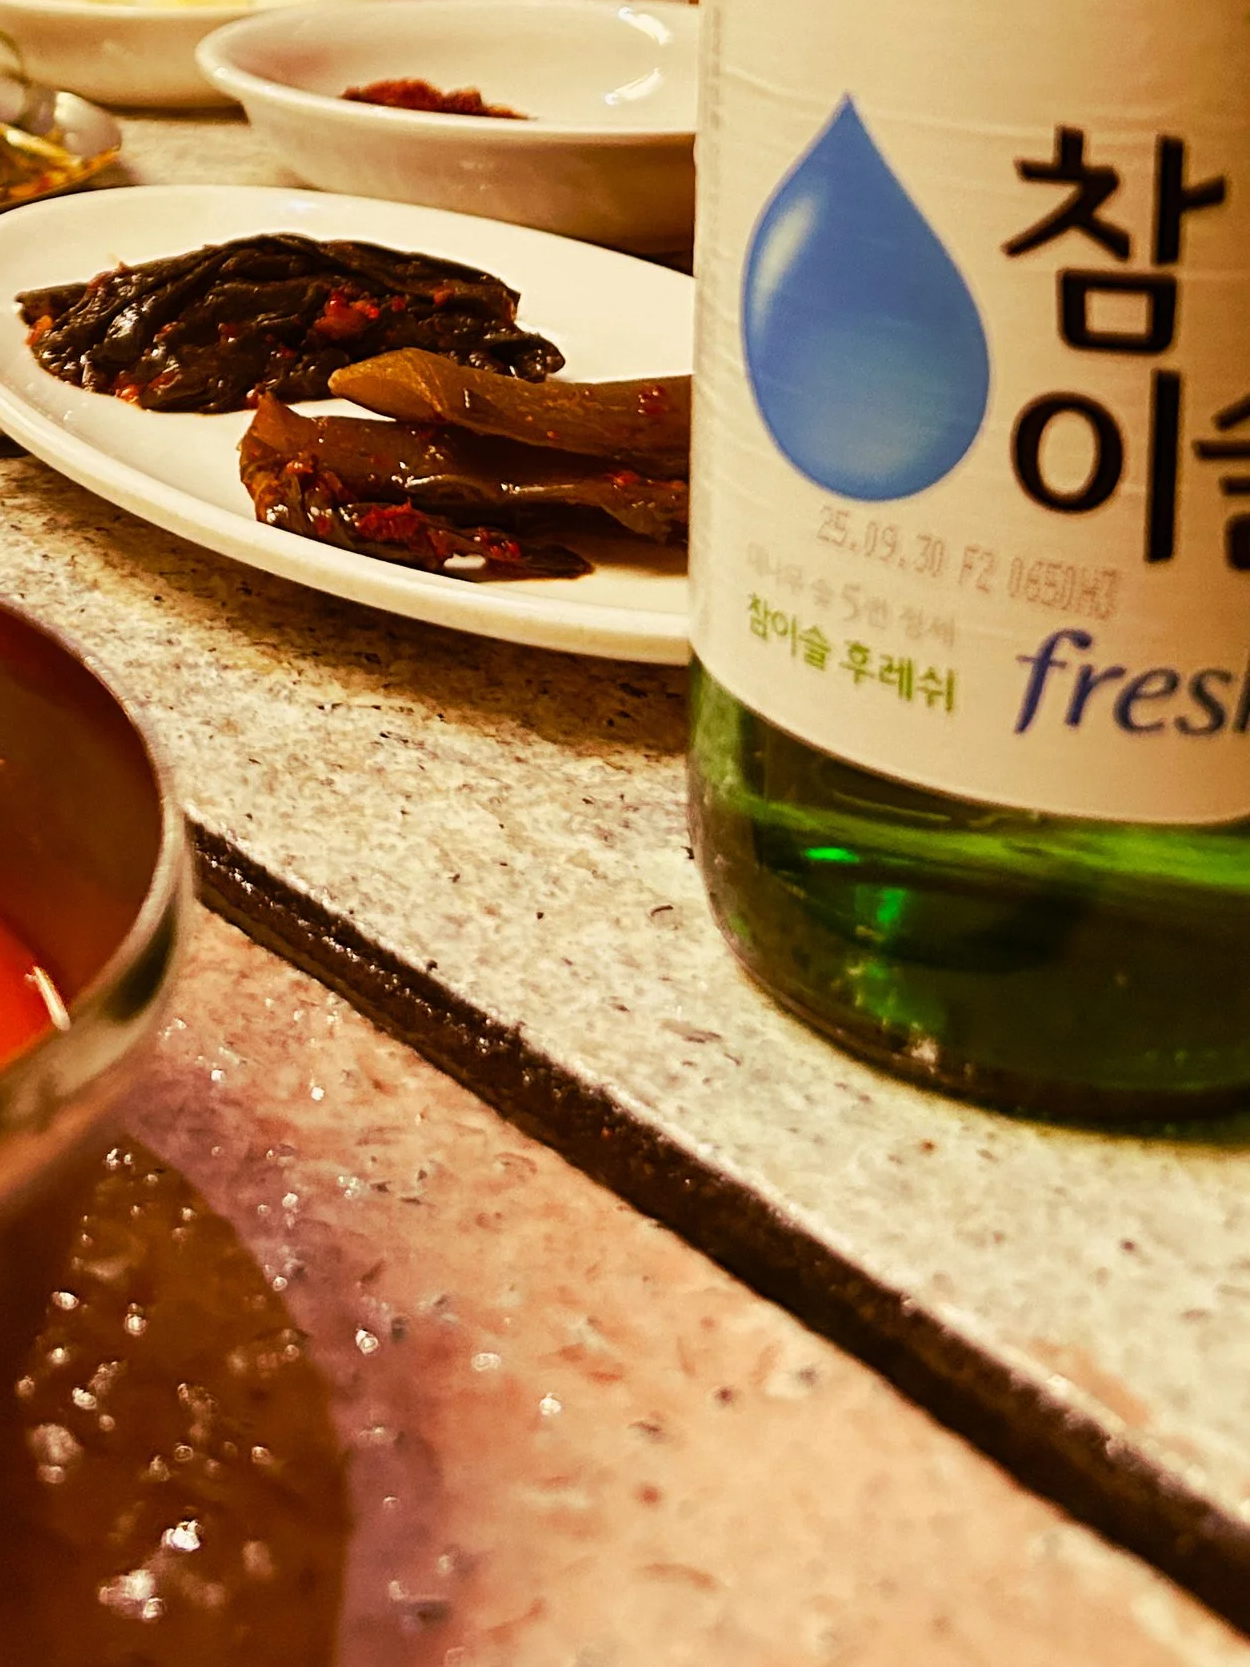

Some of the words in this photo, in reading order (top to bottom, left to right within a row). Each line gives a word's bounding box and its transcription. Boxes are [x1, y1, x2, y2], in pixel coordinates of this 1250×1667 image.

[1001, 125, 1226, 356] 참
[816, 504, 946, 578] 25.09.30
[957, 544, 995, 594] F2
[747, 591, 832, 672] 참이슬
[838, 637, 956, 714] 후레쉬
